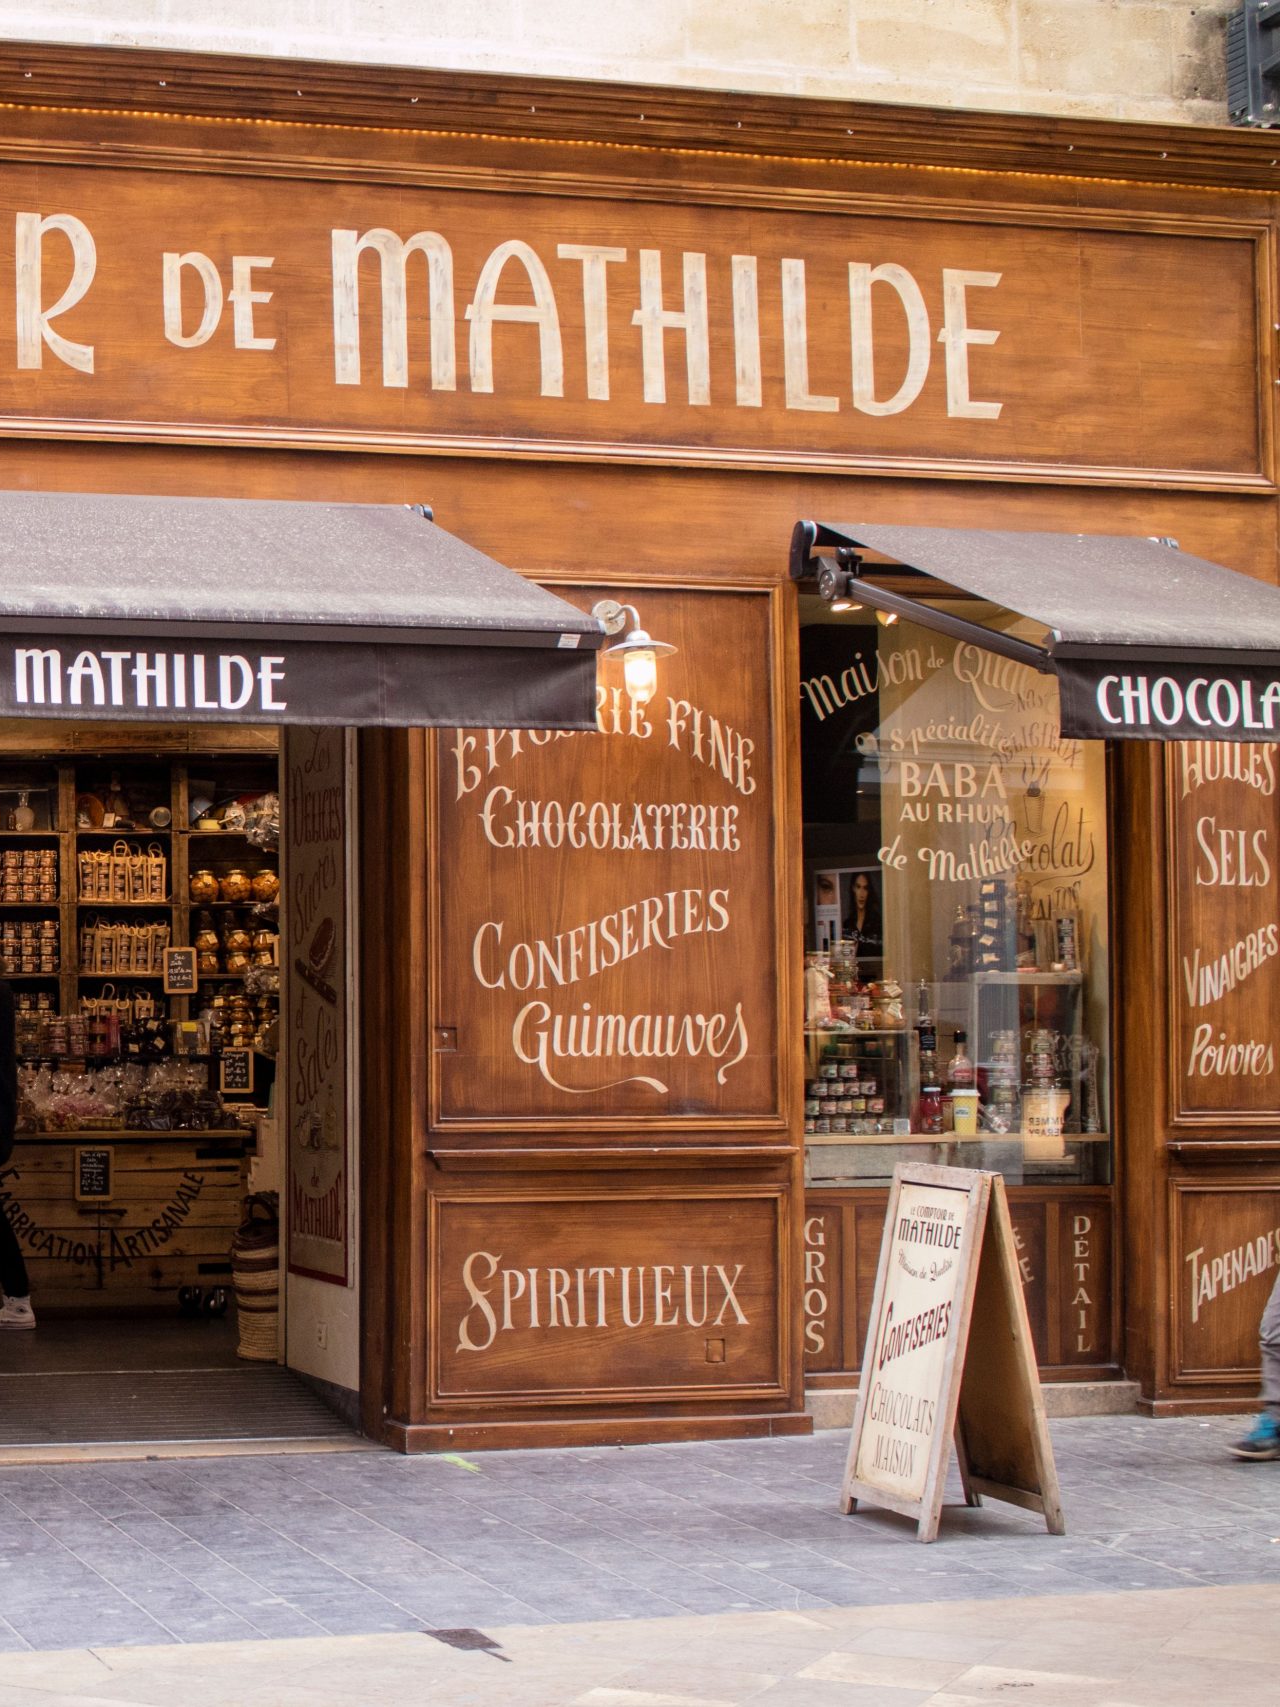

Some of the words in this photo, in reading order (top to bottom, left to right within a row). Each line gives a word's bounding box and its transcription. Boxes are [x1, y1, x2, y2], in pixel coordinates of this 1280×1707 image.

[162, 250, 276, 350] DE
[330, 227, 1004, 420] MATHILDE
[15, 647, 288, 711] MATHILDE
[799, 648, 924, 721] Maison
[926, 645, 946, 670] de
[666, 696, 757, 796] FINE
[889, 713, 1014, 756] Spécialité
[899, 760, 1008, 799] BABA
[899, 802, 930, 823] AU
[937, 803, 1011, 824] RHUM
[478, 785, 741, 853] CHOCOLATERIE
[1195, 815, 1272, 888] SELS
[877, 834, 908, 871] de
[917, 833, 1037, 882] Mathilde
[472, 888, 730, 992] CONFISERIES
[1182, 922, 1280, 1008] VINAIGRES
[295, 1006, 338, 1106] Salés
[512, 1000, 750, 1093] Guimauves
[1186, 1022, 1275, 1077] Poivres
[109, 1172, 205, 1272] ARTISANALE
[293, 1171, 342, 1242] MATHILDE
[897, 1217, 963, 1250] MATHILDE
[916, 1205, 948, 1221] COMPTOIR
[454, 1250, 752, 1355] SPIRITUEUX
[803, 1216, 829, 1355] GROS
[878, 1299, 953, 1372] CONFISERIES
[869, 1381, 936, 1437] CHOCOLATS
[871, 1434, 918, 1479] MAISON
